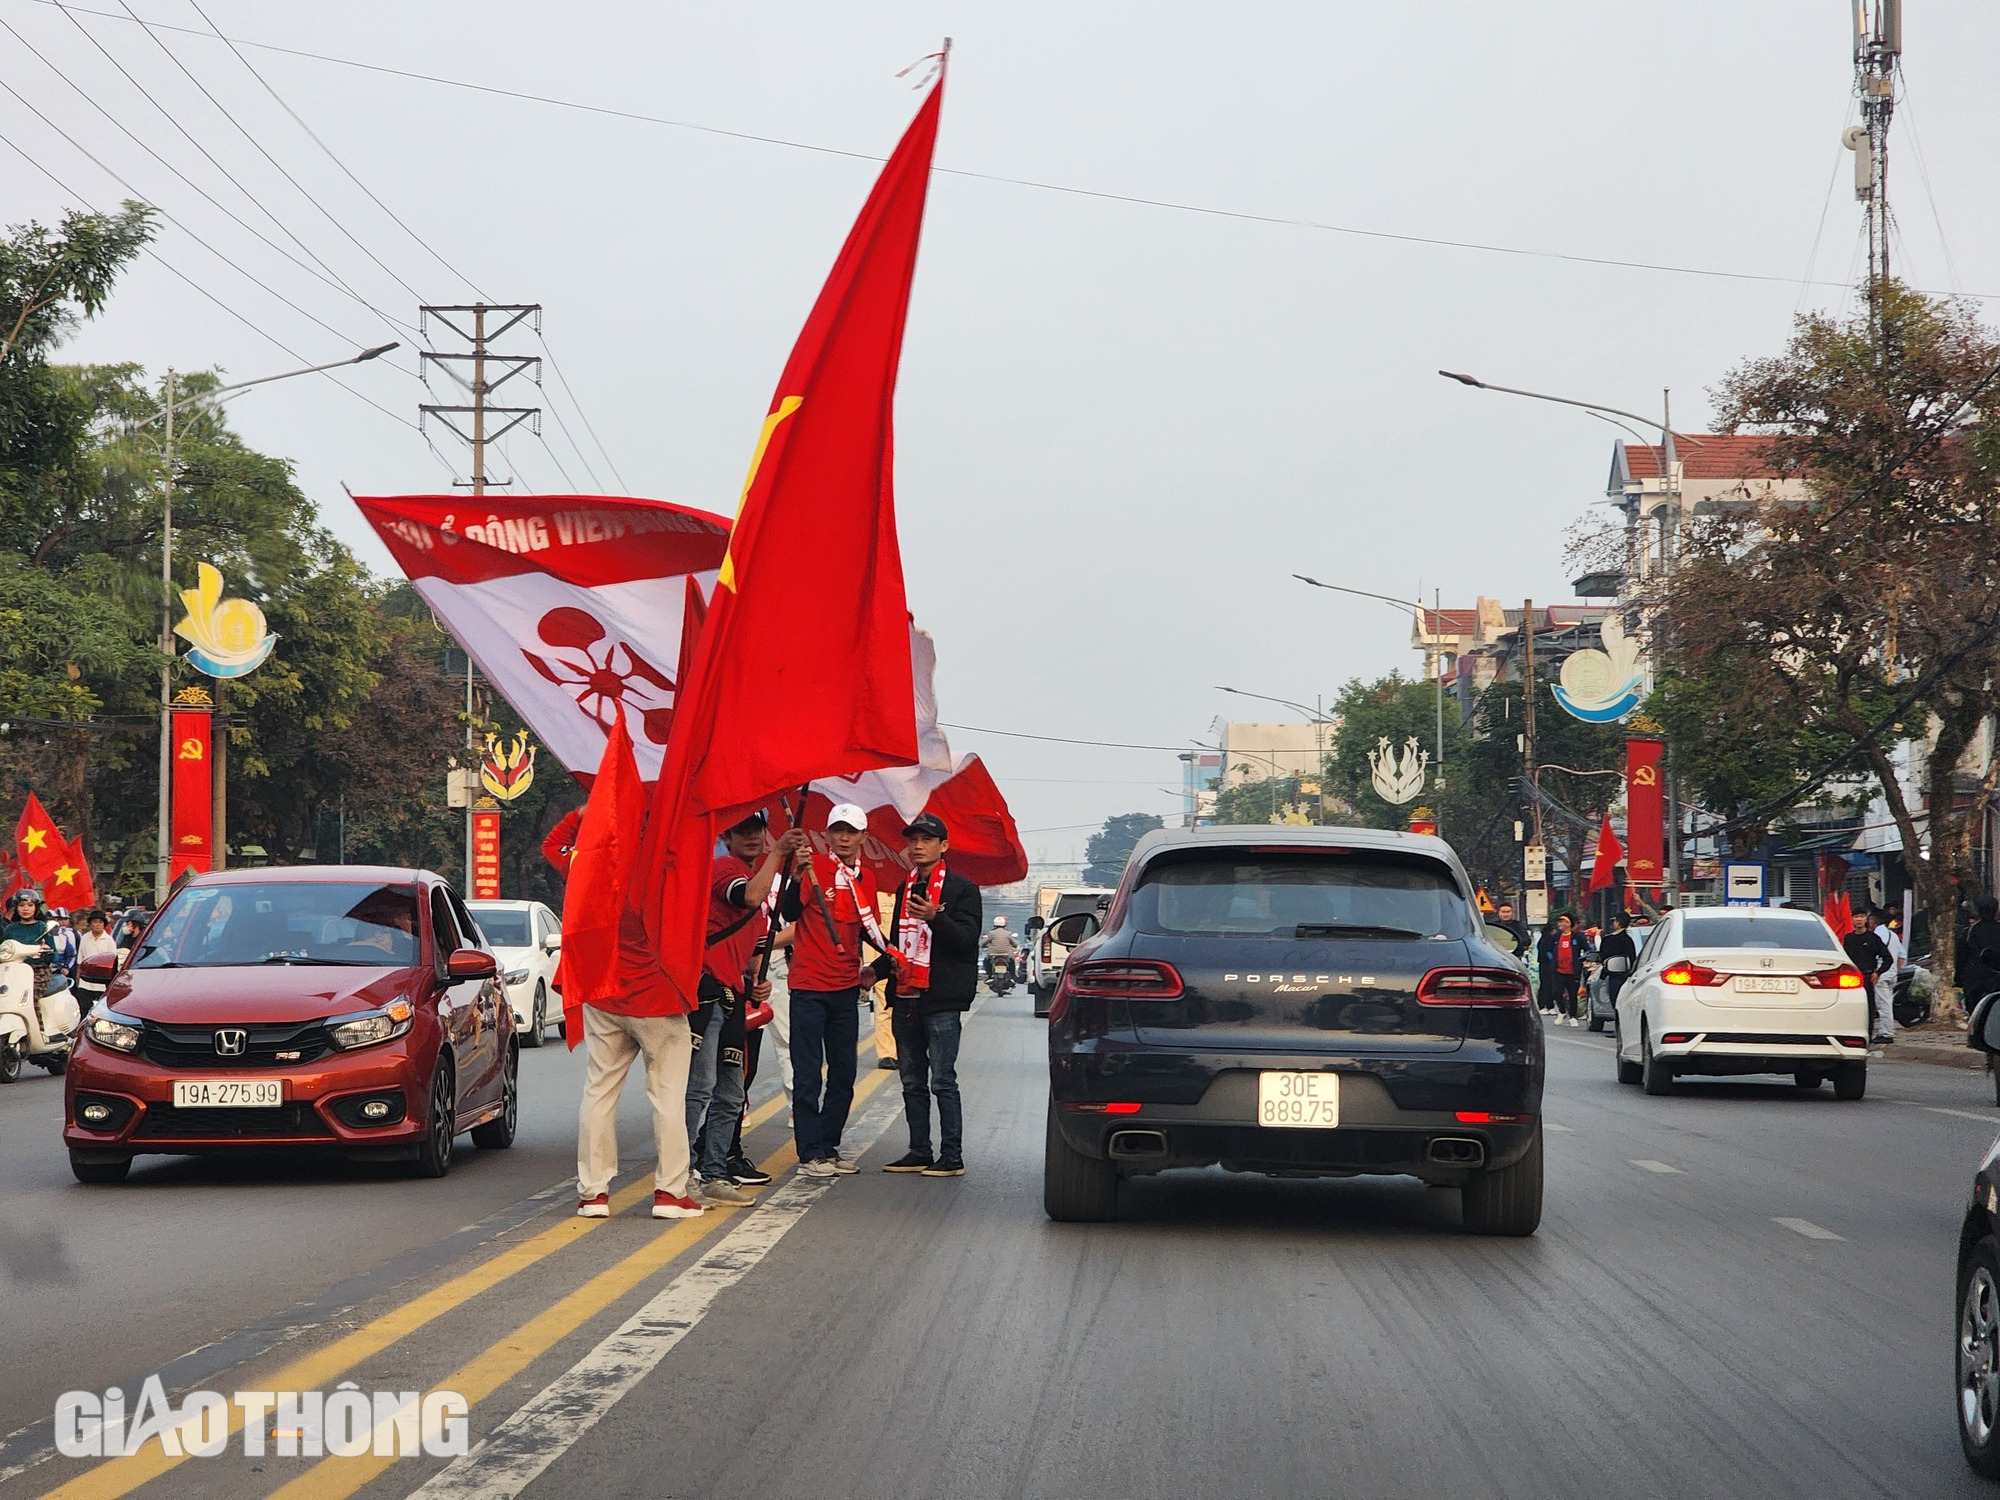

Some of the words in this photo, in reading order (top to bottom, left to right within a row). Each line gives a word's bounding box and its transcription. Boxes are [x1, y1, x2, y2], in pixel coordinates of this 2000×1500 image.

[1224, 974, 1376, 985] PORSCHE
[1273, 984, 1319, 993] Macan
[275, 1051, 301, 1061] RS
[179, 1083, 279, 1104] 19A-275.99
[1279, 1075, 1319, 1098] 30E
[1263, 1100, 1335, 1123] 889.75
